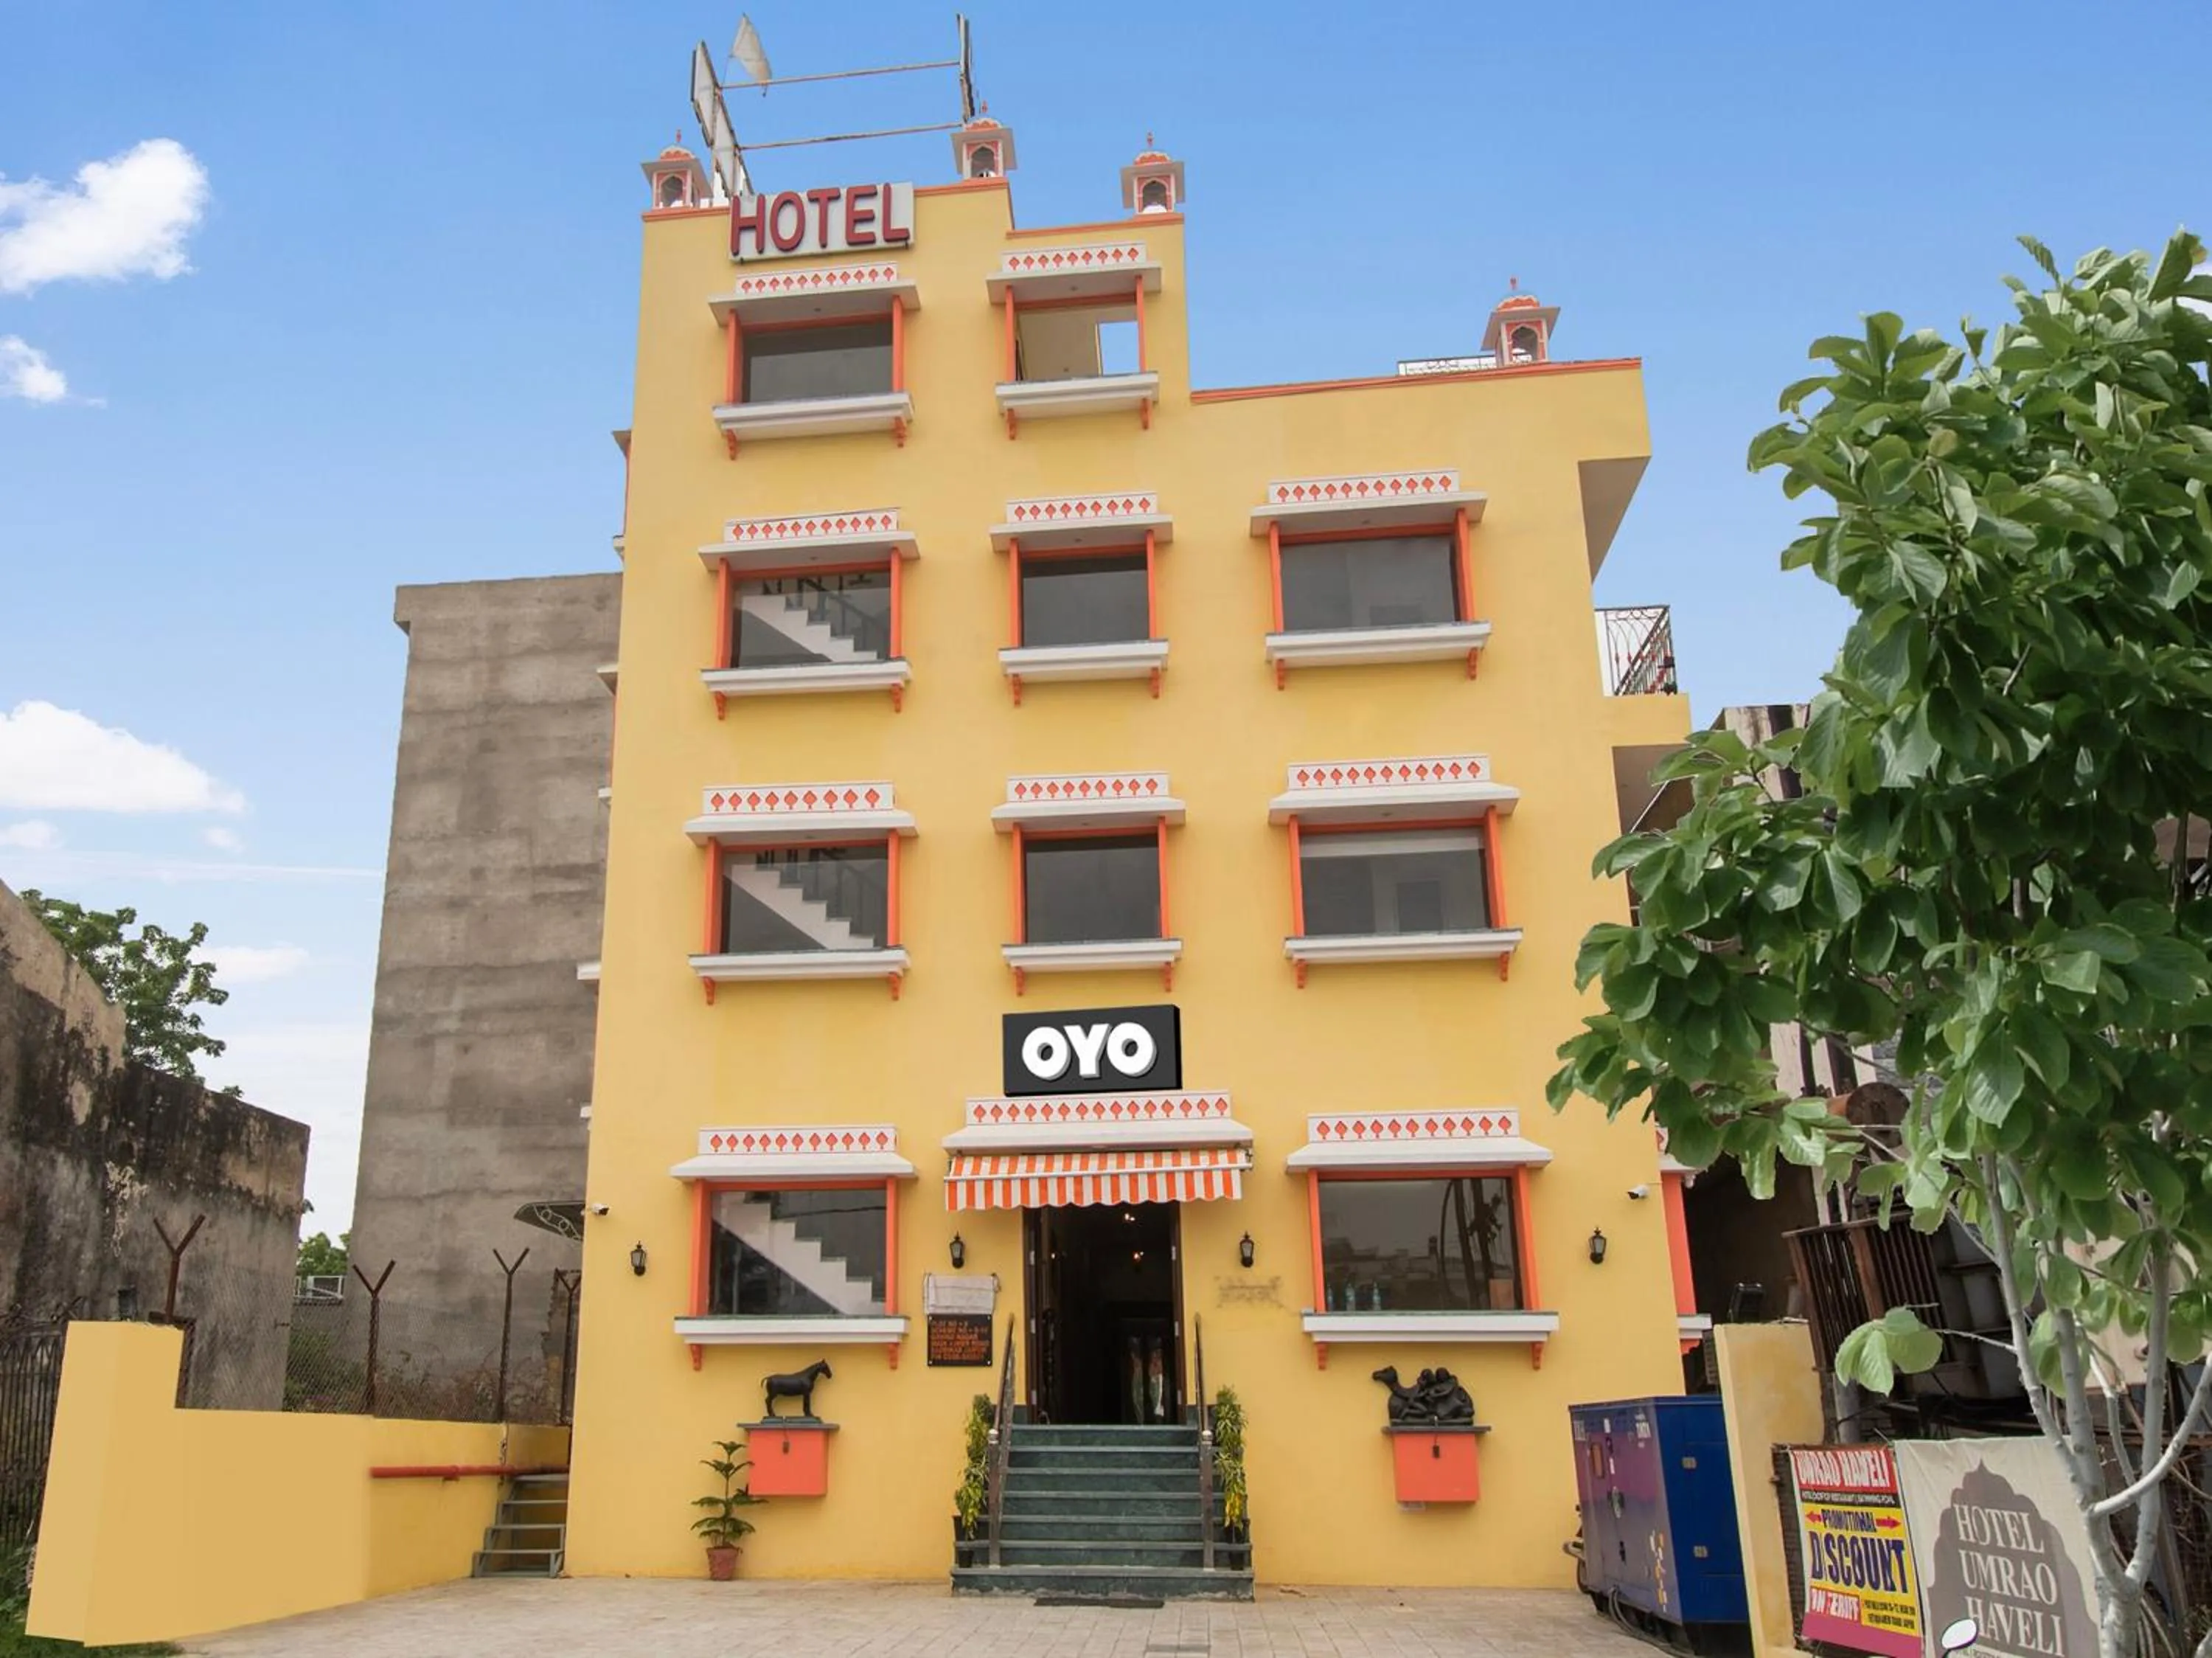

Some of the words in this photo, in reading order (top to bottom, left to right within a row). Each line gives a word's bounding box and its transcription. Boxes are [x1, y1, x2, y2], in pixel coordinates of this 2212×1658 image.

[731, 183, 911, 256] HOTEL
[1022, 1022, 1158, 1081] OYO
[1953, 1503, 2045, 1554] HOTEL
[1809, 1530, 1908, 1594] DSCOUNT
[1958, 1549, 2058, 1605] UMRAO
[1964, 1595, 2065, 1657] HAVELI
